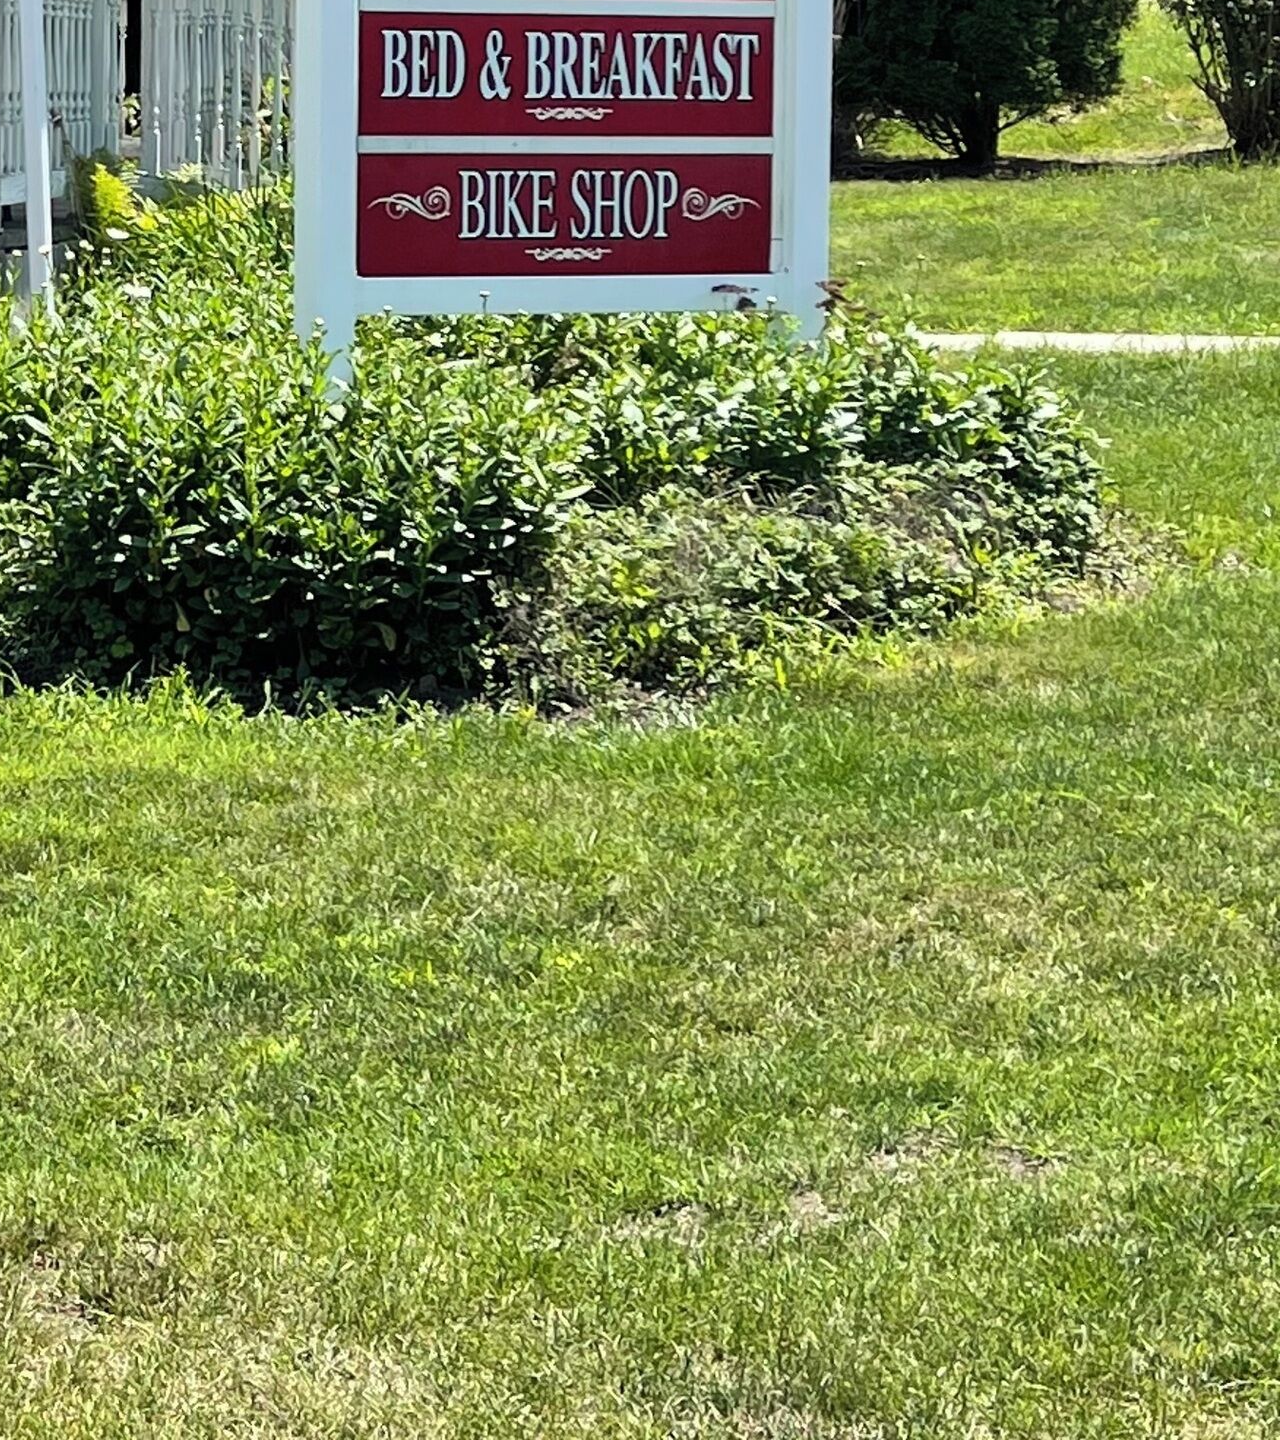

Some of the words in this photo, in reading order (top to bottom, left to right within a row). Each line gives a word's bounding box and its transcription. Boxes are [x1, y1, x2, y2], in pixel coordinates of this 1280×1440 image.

[380, 30, 467, 98] BED
[479, 30, 512, 100] &
[524, 31, 760, 101] BREAKFAST
[458, 170, 558, 238] BIKE
[570, 169, 679, 239] SHOP
